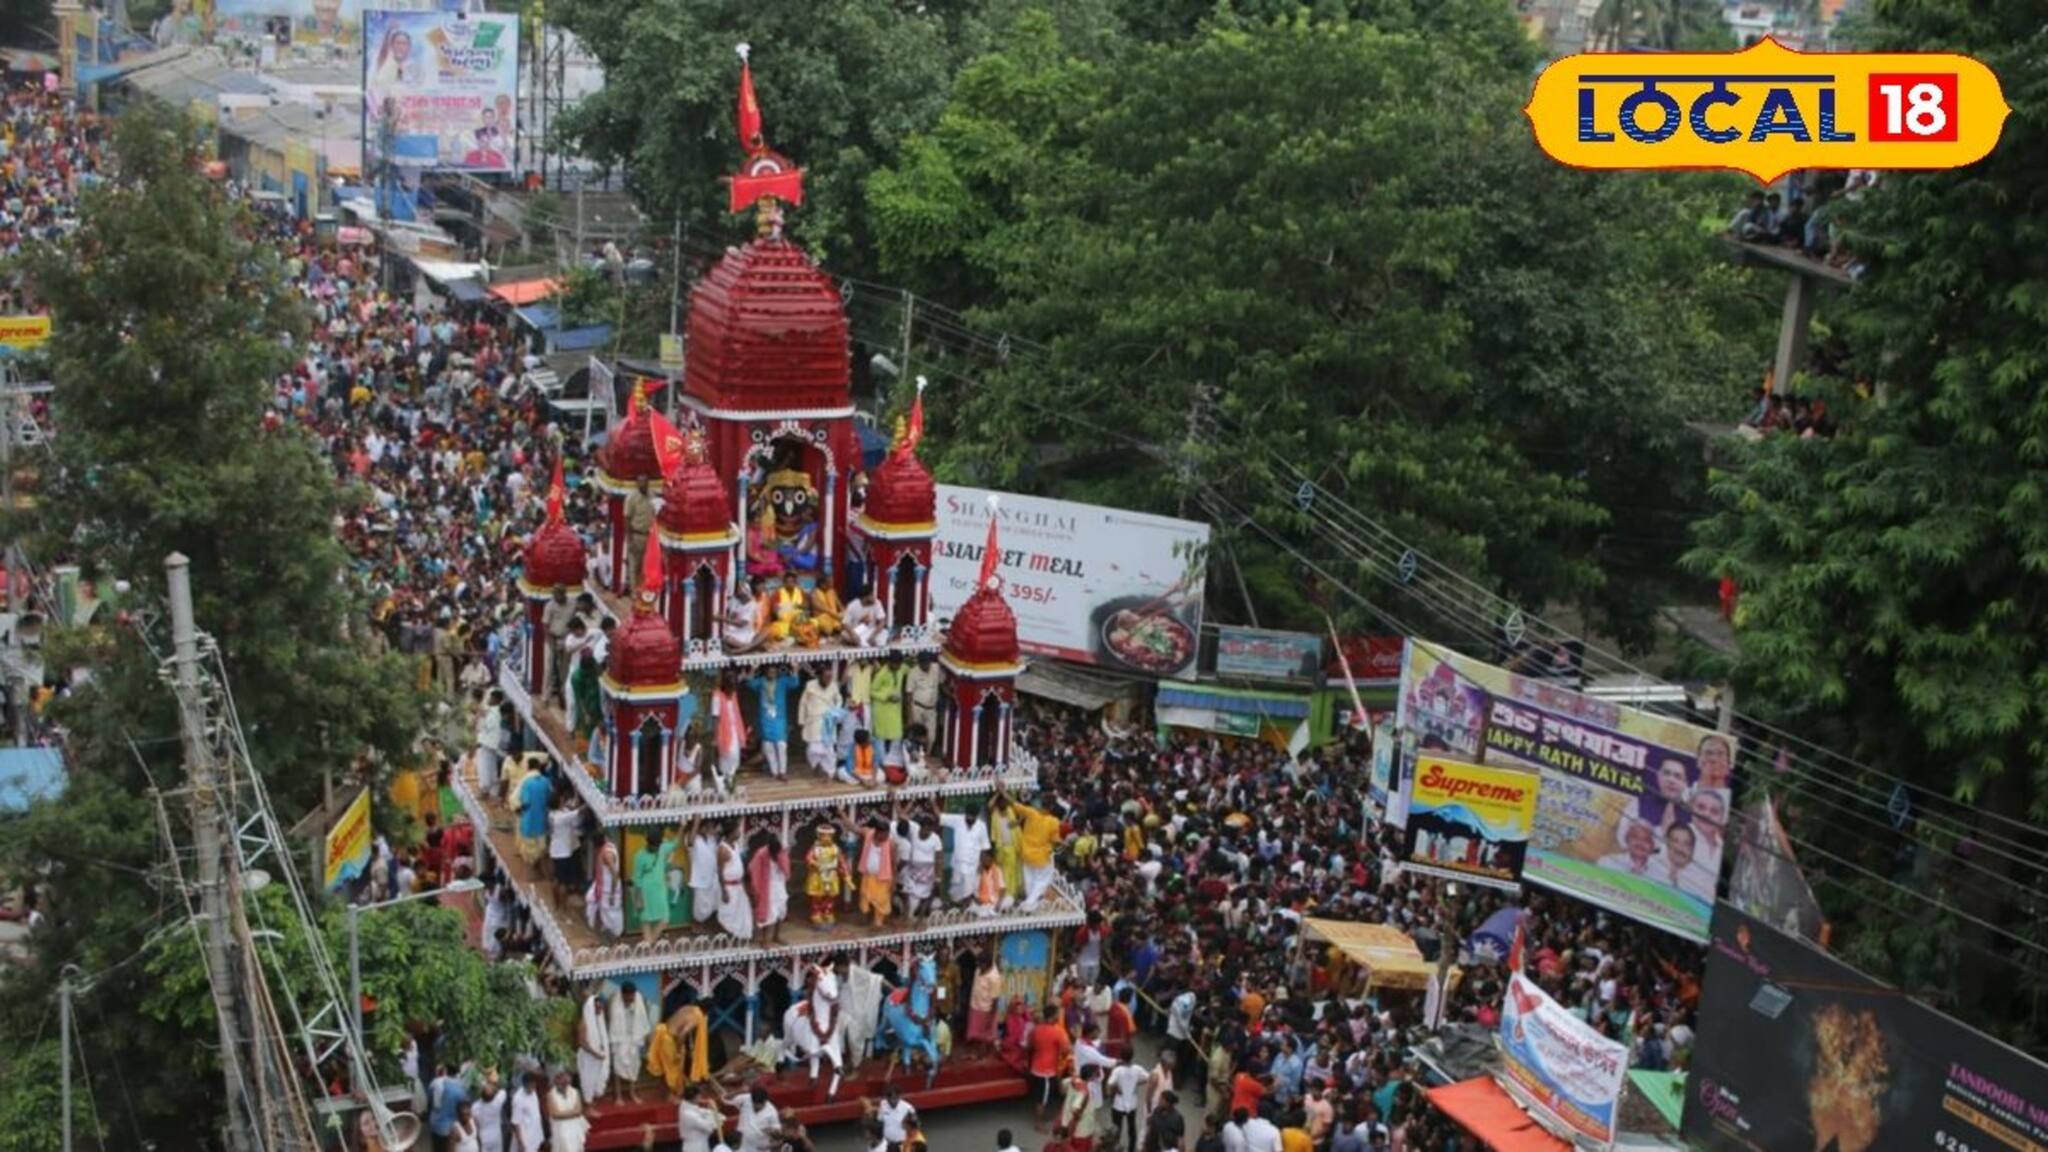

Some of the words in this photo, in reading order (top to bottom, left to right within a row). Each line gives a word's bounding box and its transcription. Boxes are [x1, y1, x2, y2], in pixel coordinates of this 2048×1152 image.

[947, 495, 1077, 532] SHANGHAI
[998, 548, 1026, 568] ET
[1029, 552, 1085, 578] MEAL
[1419, 764, 1525, 803] Supreme
[1539, 744, 1585, 774] RATH
[1588, 759, 1645, 793] YATRA
